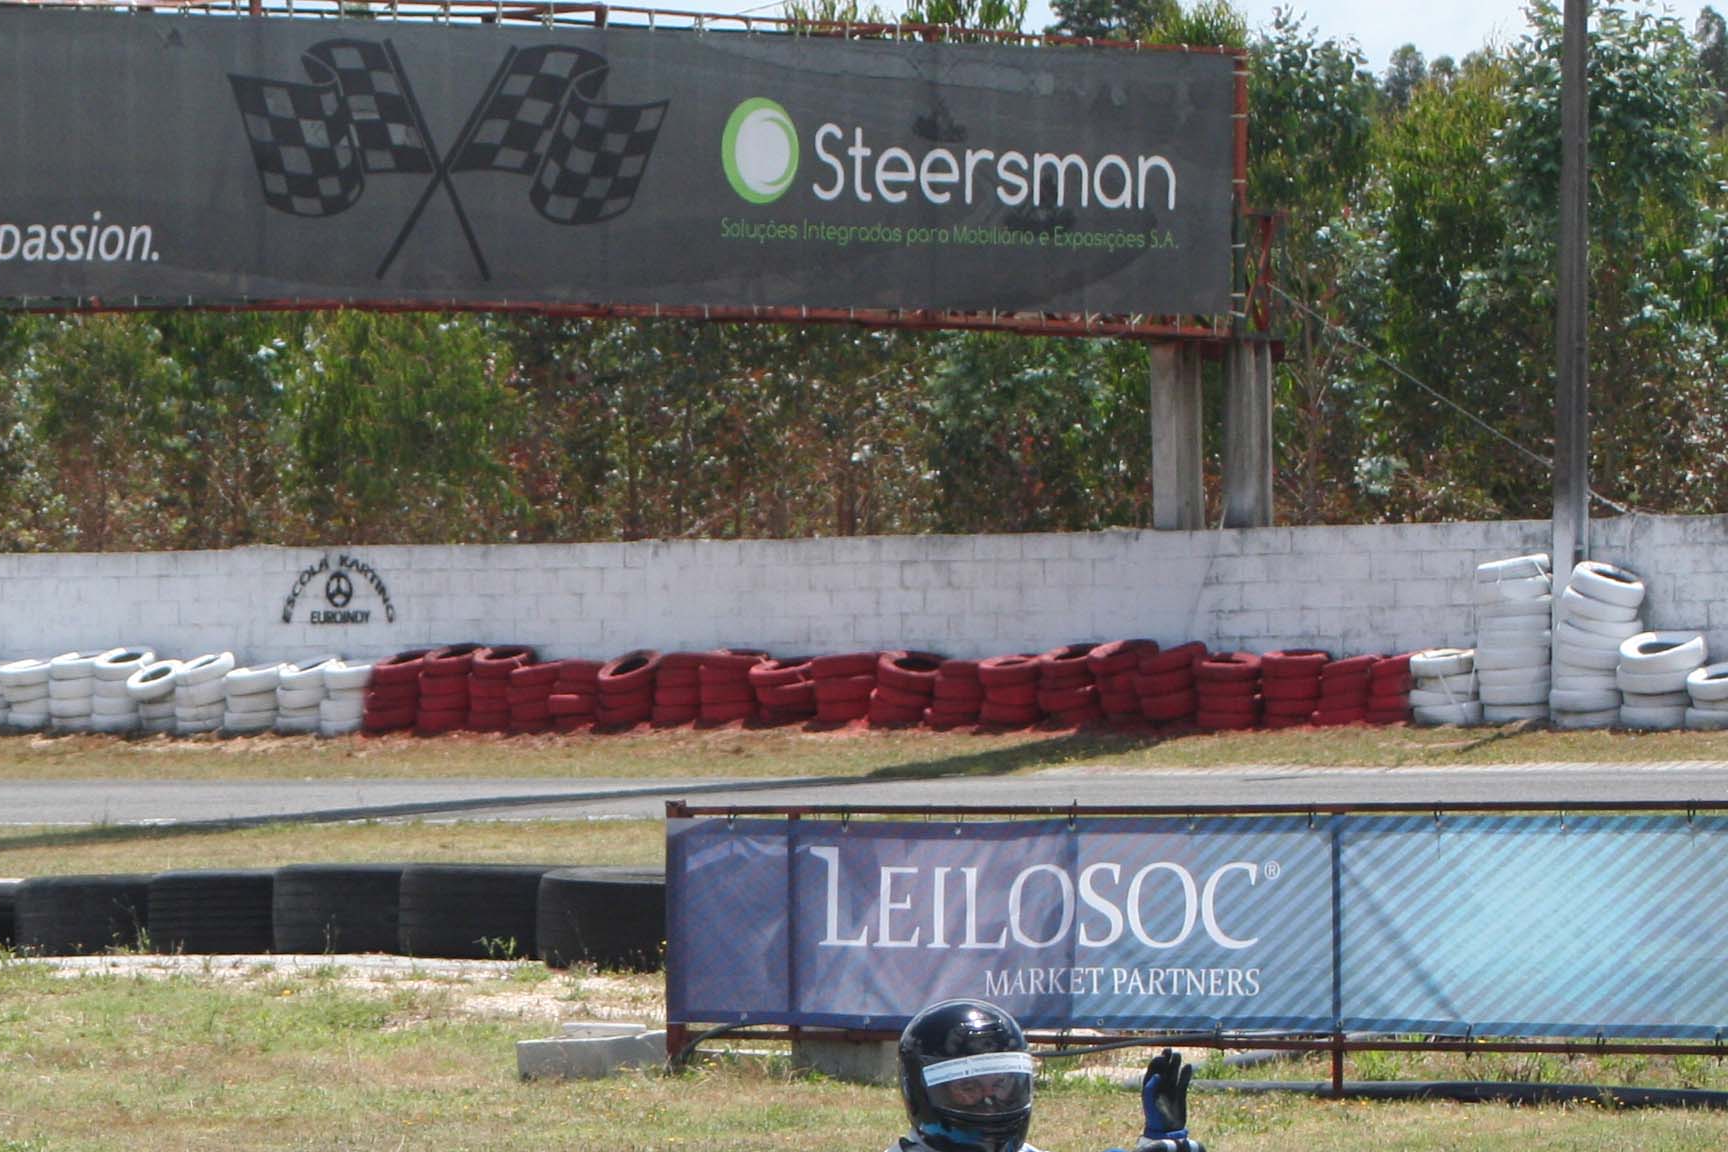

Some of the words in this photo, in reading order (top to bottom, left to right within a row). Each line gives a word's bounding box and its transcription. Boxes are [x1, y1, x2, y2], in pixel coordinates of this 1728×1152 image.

[812, 122, 1176, 210] Steersman
[720, 217, 799, 244] Soluções
[803, 217, 902, 247] Integradas
[906, 226, 949, 247] para
[953, 225, 1035, 245] Mobiliário
[1038, 230, 1050, 246] e
[1053, 226, 1145, 252] Exposições
[984, 966, 1104, 997] MARKET
[1112, 967, 1261, 998] PARTNERS
